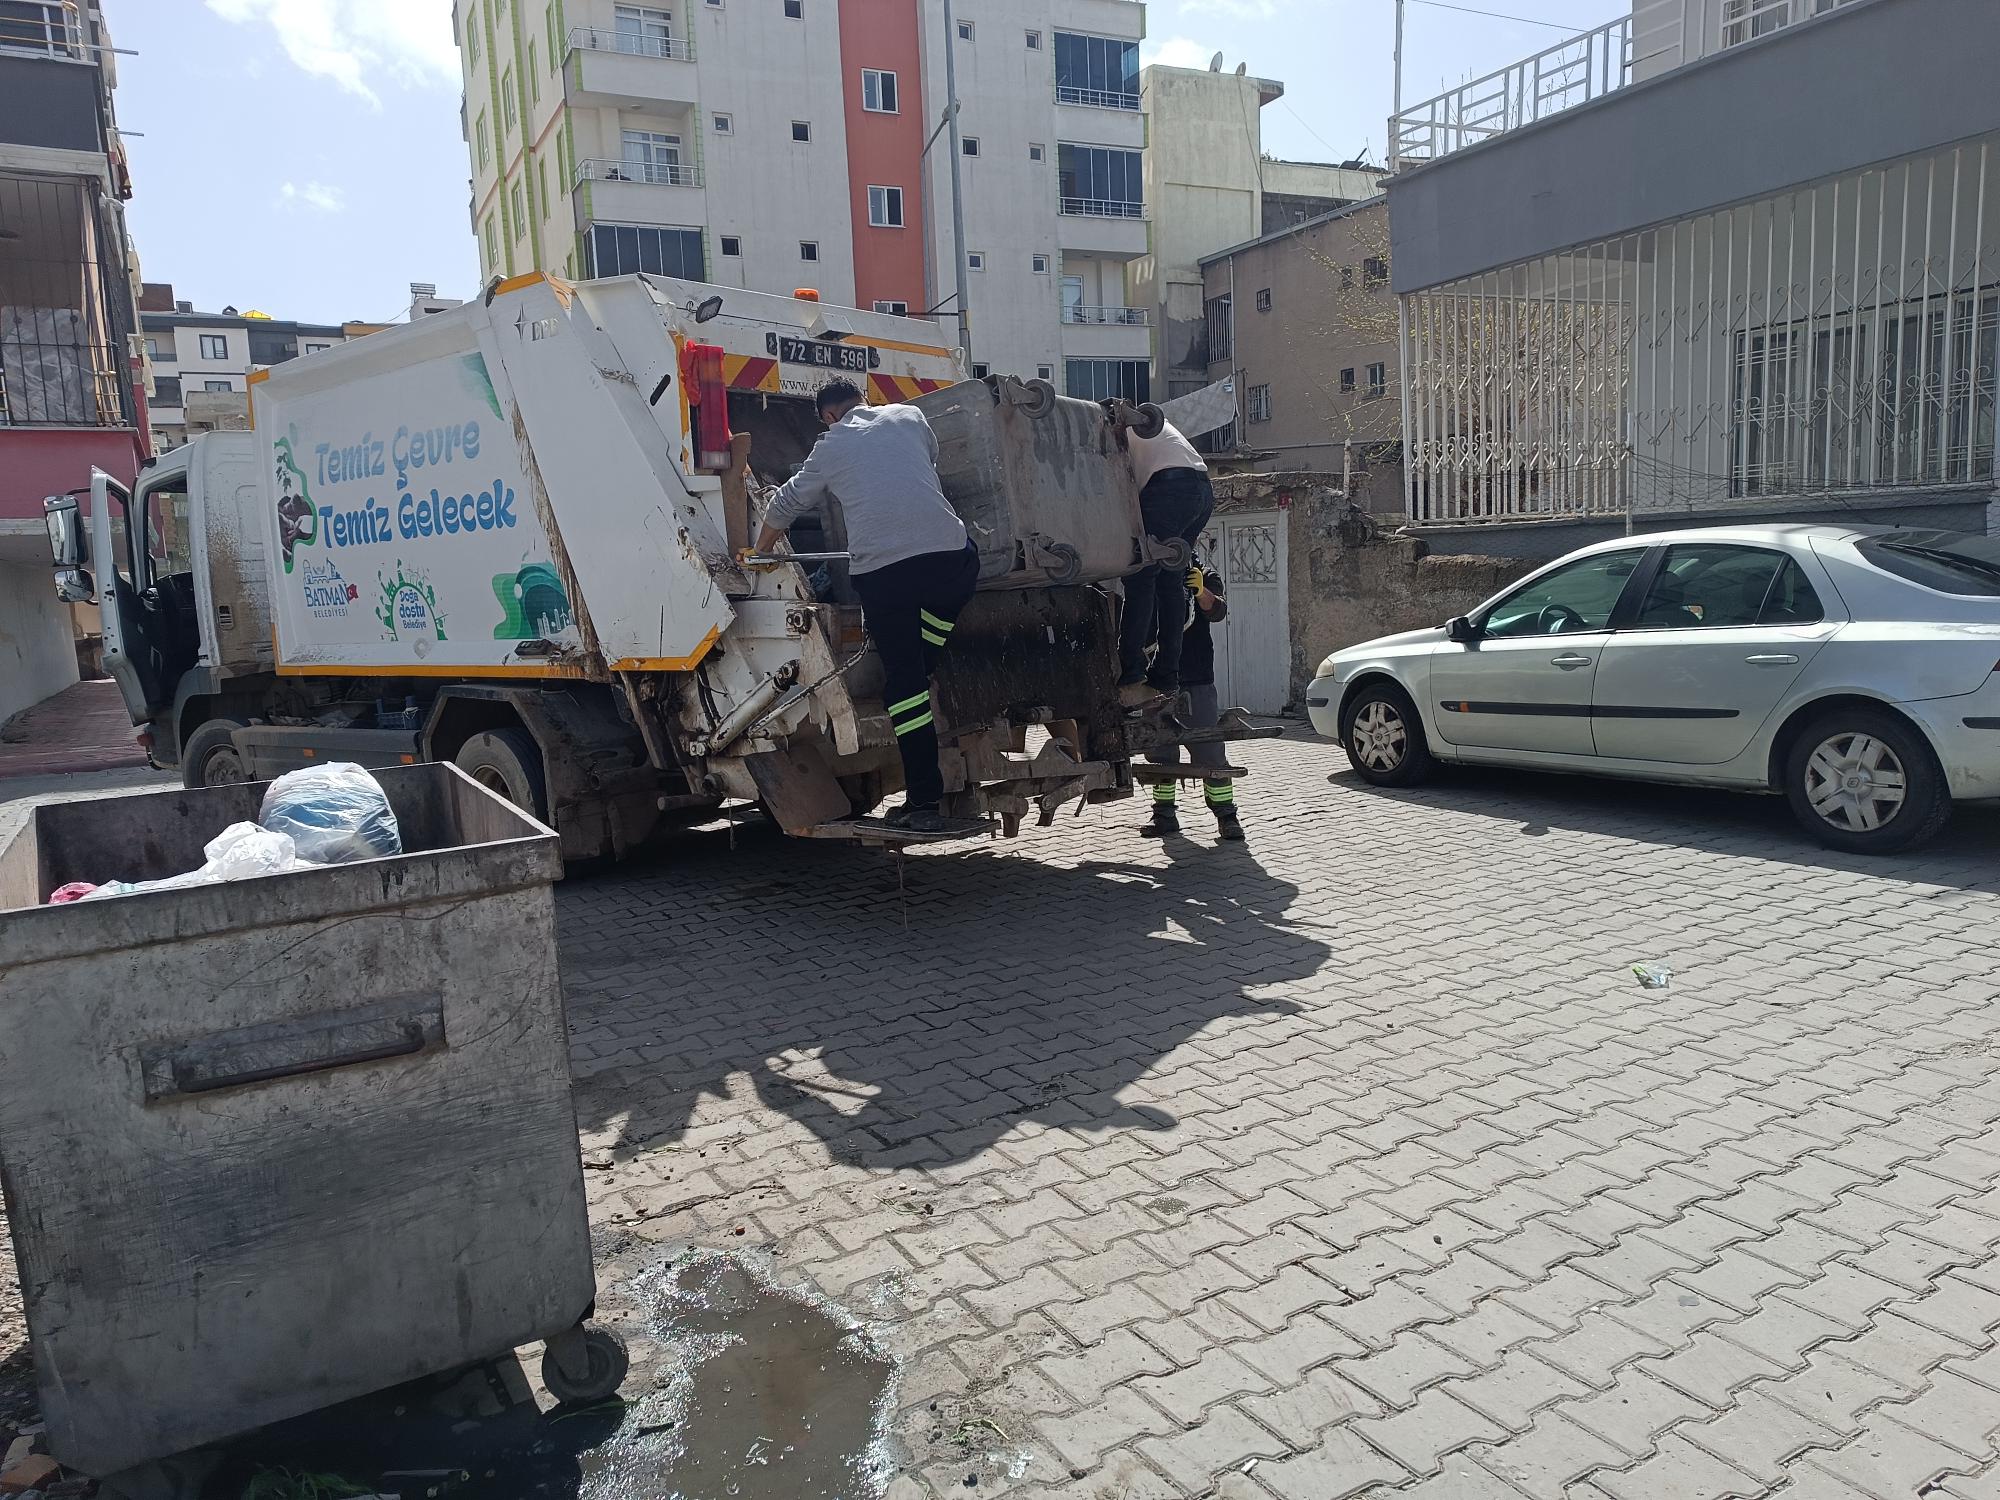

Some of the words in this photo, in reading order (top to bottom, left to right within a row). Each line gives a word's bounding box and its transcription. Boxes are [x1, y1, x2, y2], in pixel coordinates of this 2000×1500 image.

[788, 341, 806, 361] 72
[815, 345, 831, 364] EN
[840, 349, 864, 369] 596
[315, 432, 385, 486] Temiz
[392, 420, 480, 491] Çevre
[319, 497, 392, 549] Temiz
[397, 478, 517, 540] Gelecek
[304, 583, 350, 607] BATMAN
[400, 589, 419, 603] Doğa
[313, 606, 348, 618] BELEDİYESİ
[399, 603, 425, 618] dostu
[402, 619, 427, 630] Belediye
